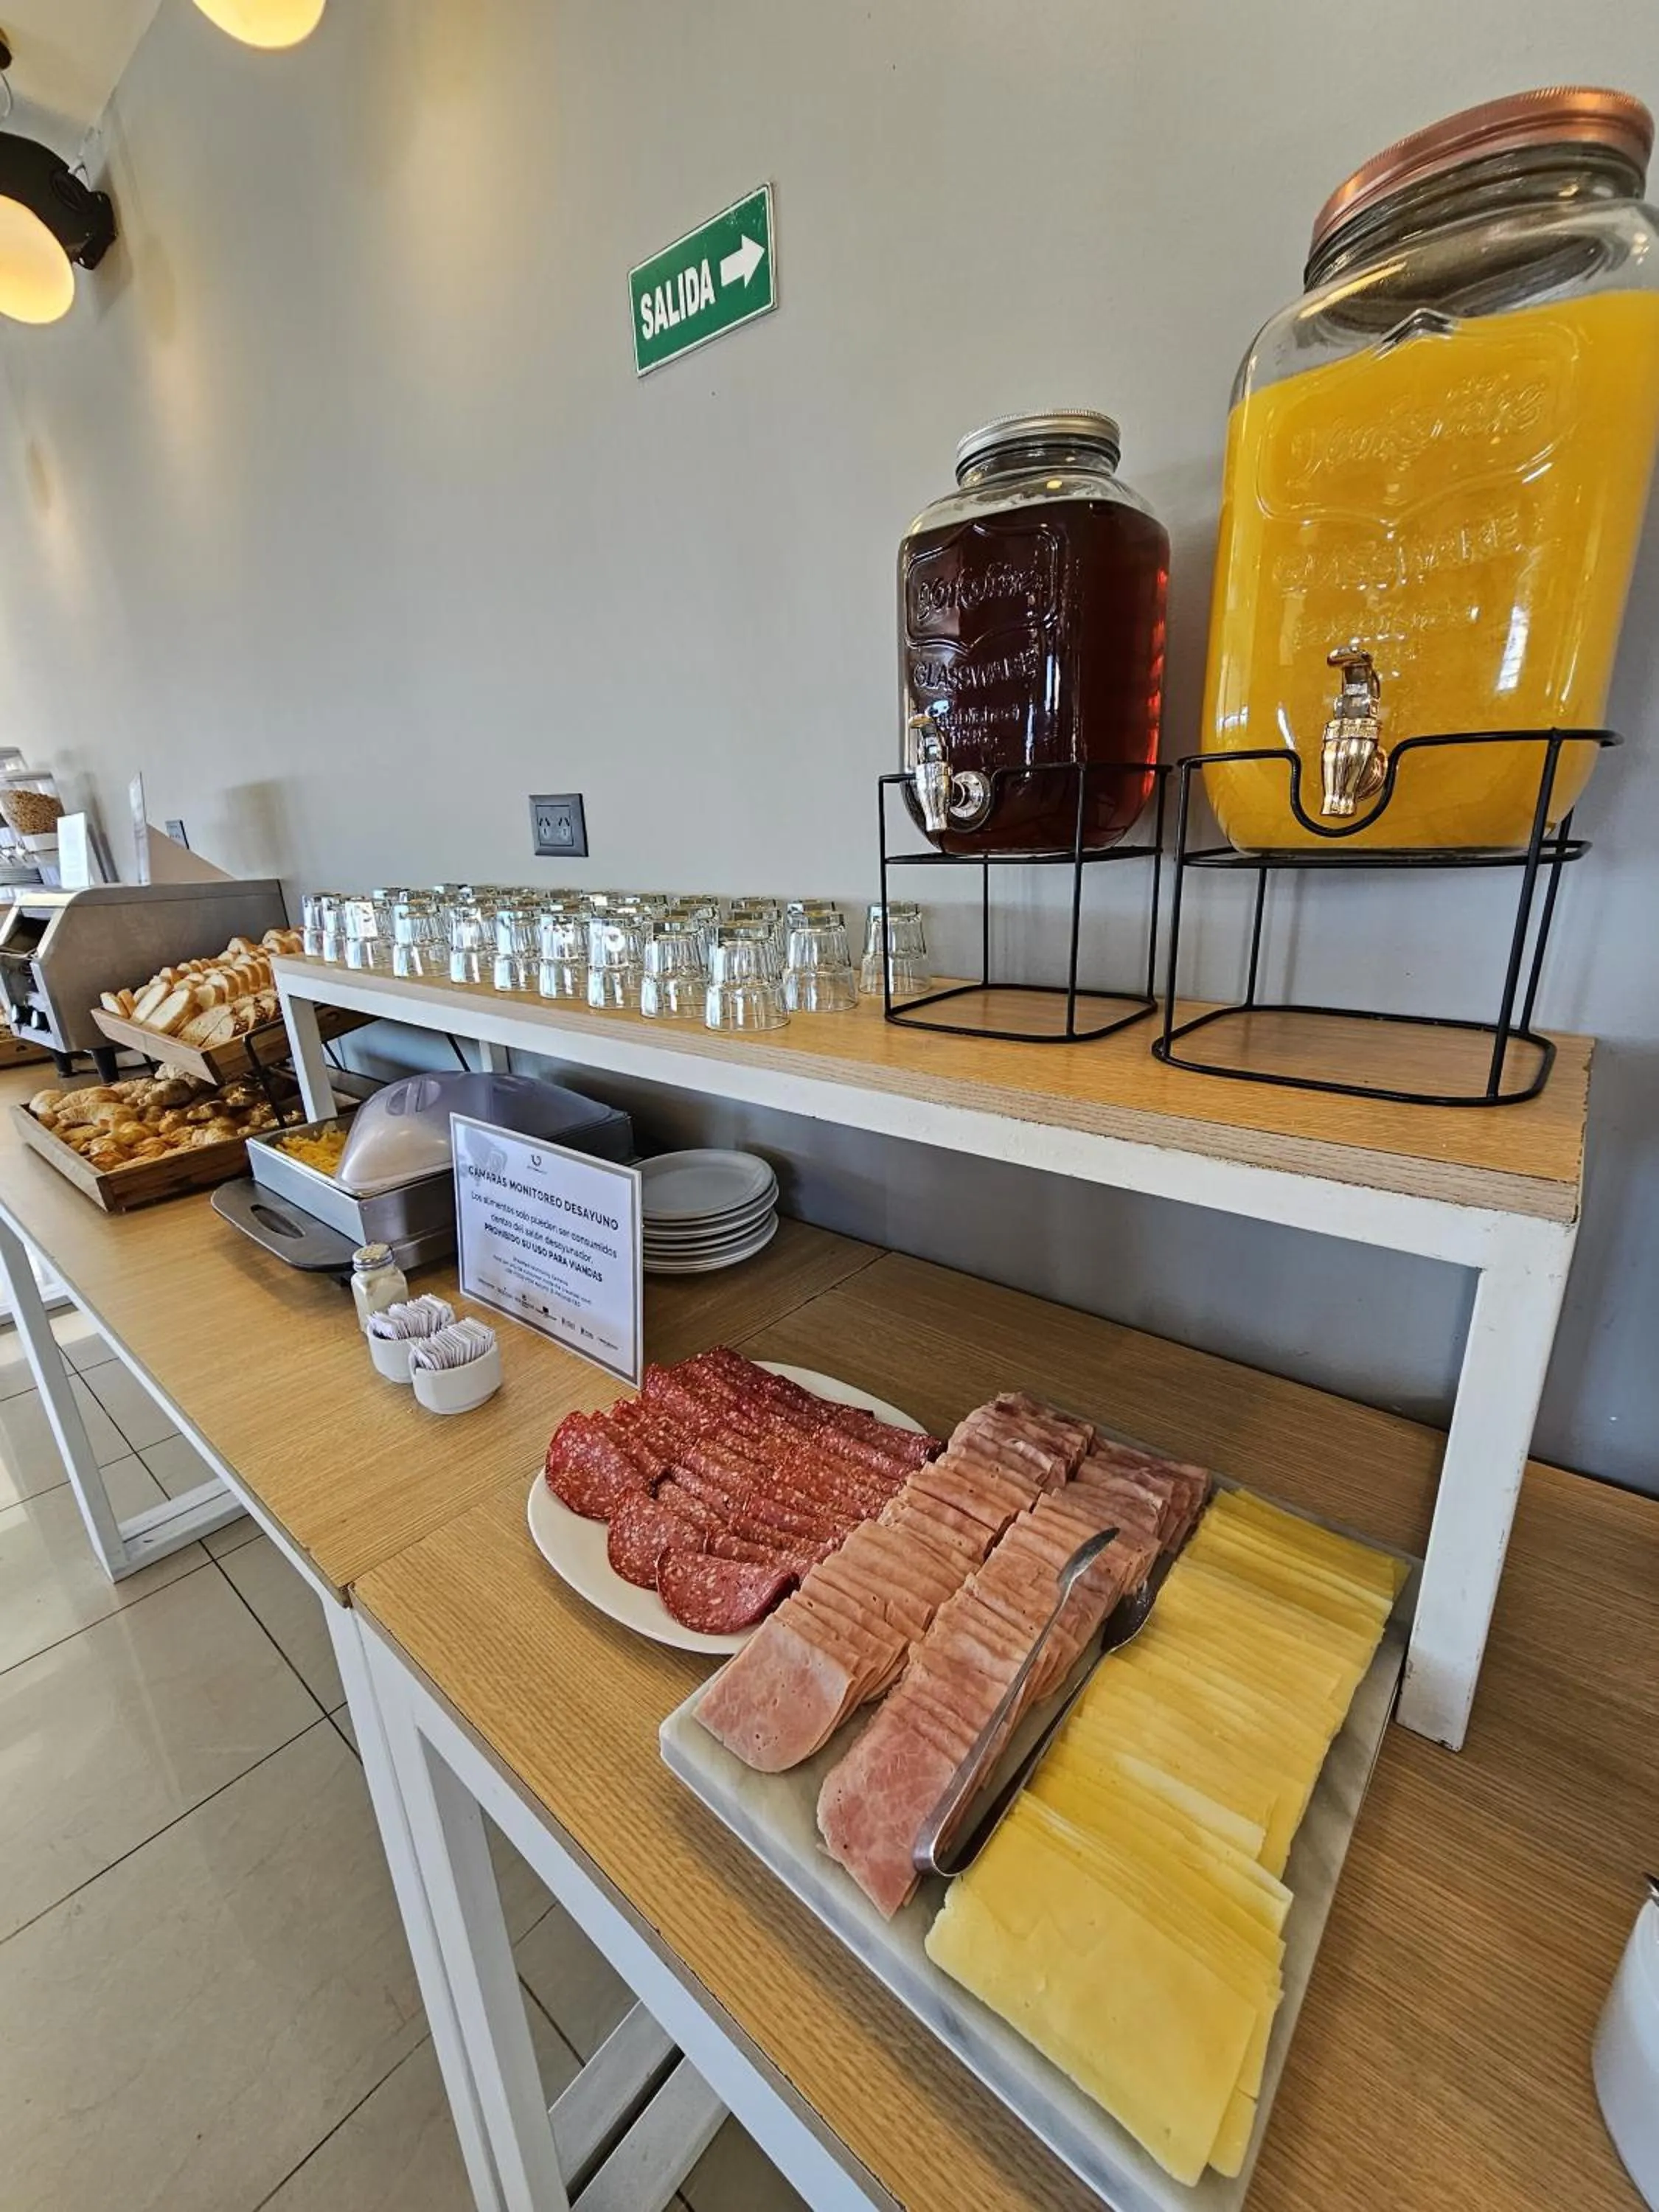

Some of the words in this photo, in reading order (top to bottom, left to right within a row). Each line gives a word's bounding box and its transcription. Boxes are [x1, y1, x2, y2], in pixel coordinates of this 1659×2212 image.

[640, 258, 715, 340] SALIDA
[509, 1180, 562, 1209] MONITOREO
[564, 1200, 619, 1231] DESAYUNO
[521, 1239, 532, 1250] SU
[532, 1242, 548, 1257] USO
[549, 1250, 568, 1267] PARA
[568, 1259, 602, 1282] VIANDAS
[571, 1232, 617, 1259] consumidos
